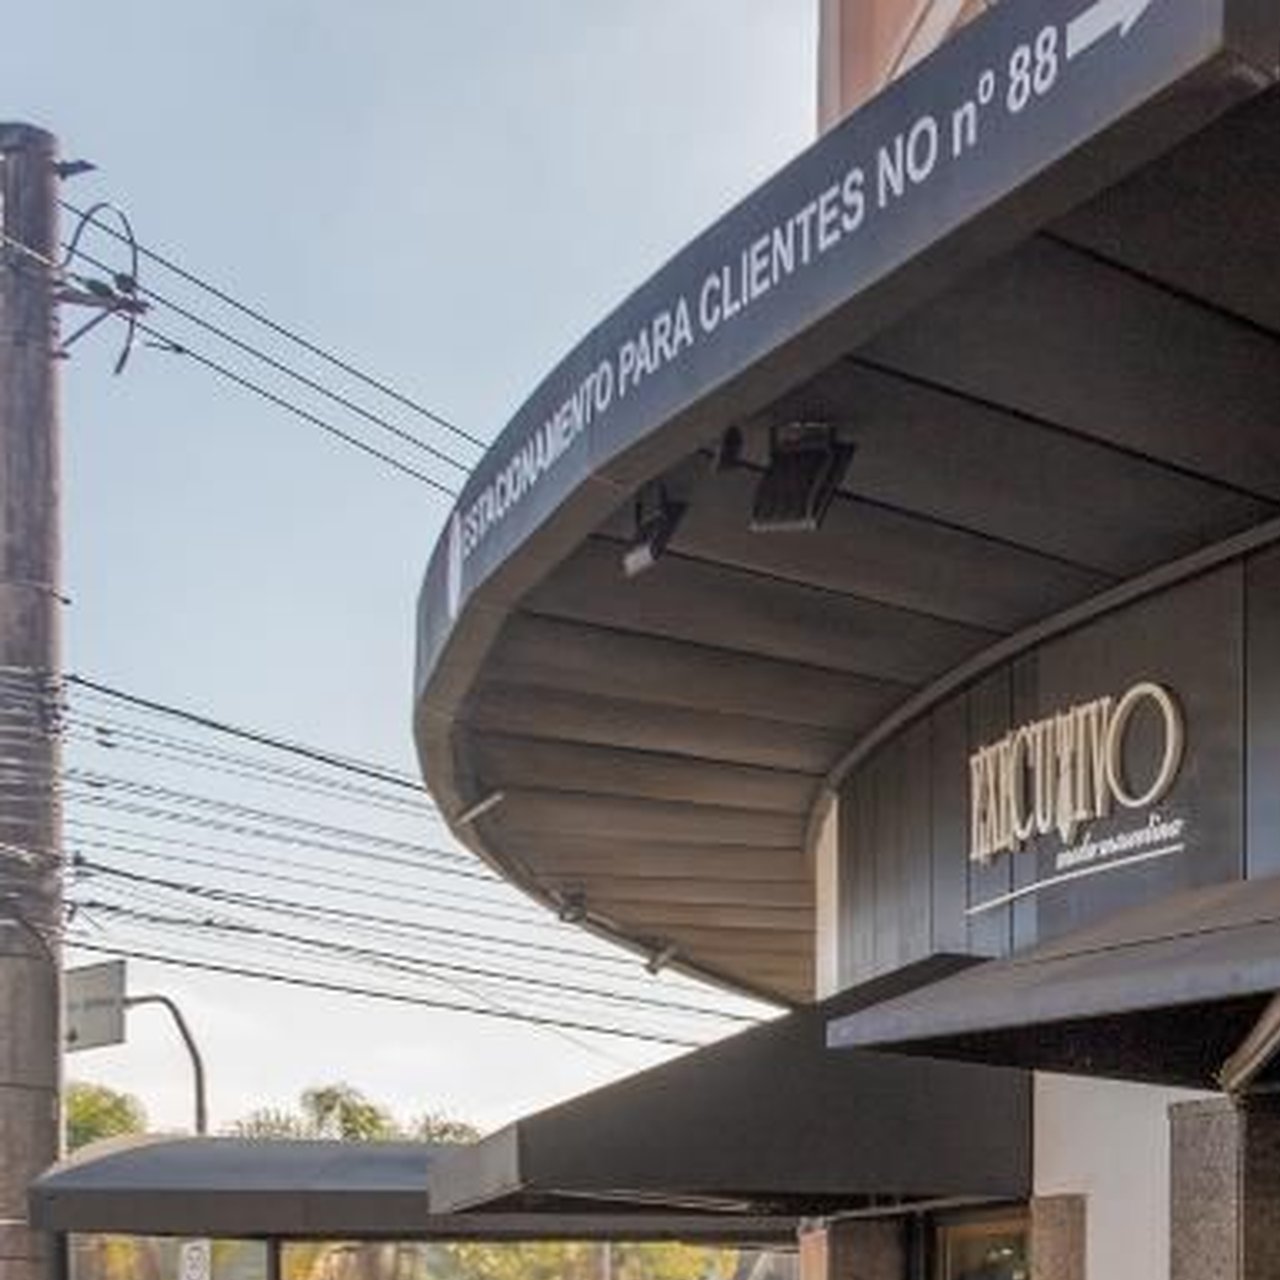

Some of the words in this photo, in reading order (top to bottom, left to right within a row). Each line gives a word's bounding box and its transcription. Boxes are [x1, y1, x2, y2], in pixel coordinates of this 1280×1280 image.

[463, 359, 613, 557] ESTACIONAMENTO
[618, 298, 694, 398] PARA
[700, 167, 865, 333] CLIENTES
[878, 114, 938, 208] NO
[1006, 24, 1058, 113] 88
